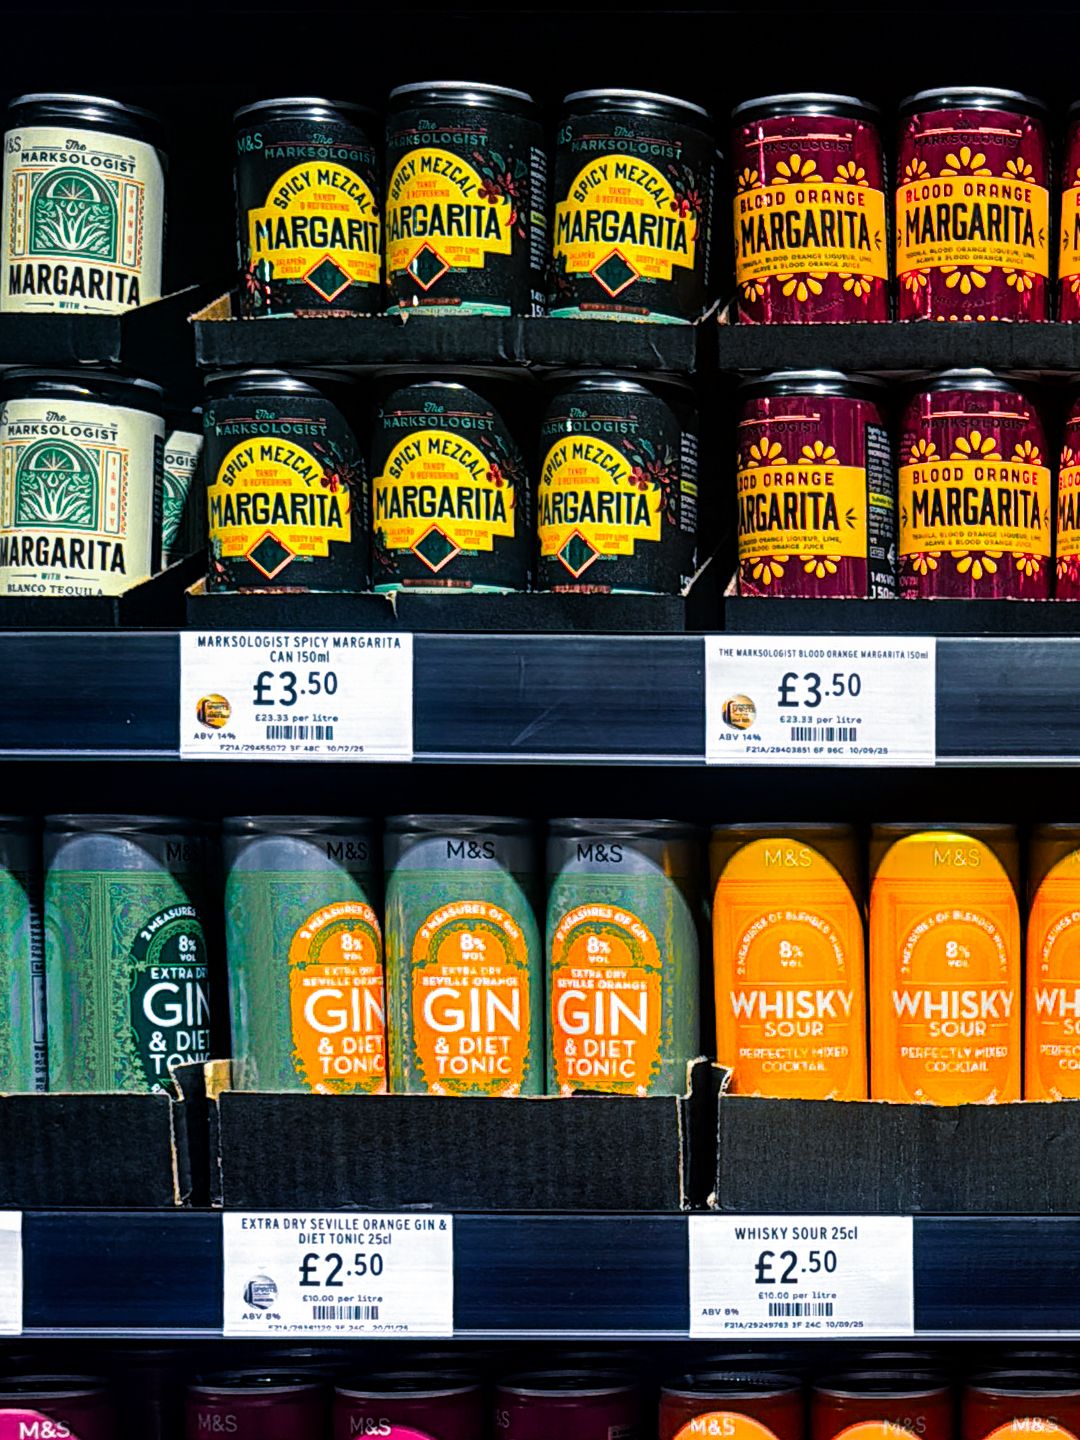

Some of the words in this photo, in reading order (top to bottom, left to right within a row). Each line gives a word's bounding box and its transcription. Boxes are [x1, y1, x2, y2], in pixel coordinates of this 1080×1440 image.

[21, 152, 137, 174] MARKSOLOGIST
[573, 158, 613, 207] SPICY
[613, 156, 668, 207] MEZCAL
[740, 190, 786, 213] BLOOD
[794, 190, 865, 206] ORANGE
[554, 207, 688, 252] MARGARITA
[741, 212, 871, 252] MARGARITA
[9, 264, 140, 305] MARGARITA
[197, 636, 289, 647] MARKSOLOGIST
[294, 636, 328, 648] SPICY
[333, 637, 401, 648] MARGARITA
[270, 651, 293, 662] CAN
[298, 651, 329, 662] 150ml
[737, 649, 796, 657] MARKSOLOGIST
[827, 650, 858, 658] ORANGE
[861, 651, 904, 659] MARGARITA
[907, 651, 928, 659] 150ml
[253, 671, 337, 706] £3.50
[778, 672, 861, 707] £3.50
[293, 715, 309, 723] per
[313, 714, 338, 722] litre
[446, 840, 496, 861] M&S
[423, 989, 521, 1034] GIN
[892, 989, 1014, 1018] WHISKY
[929, 1021, 987, 1036] SOUR
[242, 1218, 279, 1229] EXTRA
[284, 1219, 306, 1229] DRY
[311, 1219, 358, 1229] SEVILLE
[363, 1219, 410, 1230] ORANGE
[415, 1220, 434, 1230] GIN
[439, 1220, 447, 1230] &
[735, 1227, 787, 1239] WHISKY
[793, 1227, 827, 1239] SOUR
[832, 1227, 858, 1239] 25cl
[299, 1234, 324, 1244] DIET
[330, 1234, 364, 1244] TONIC
[368, 1234, 391, 1244] 25cl
[299, 1253, 383, 1286] £2.50
[755, 1250, 836, 1283] £2.50
